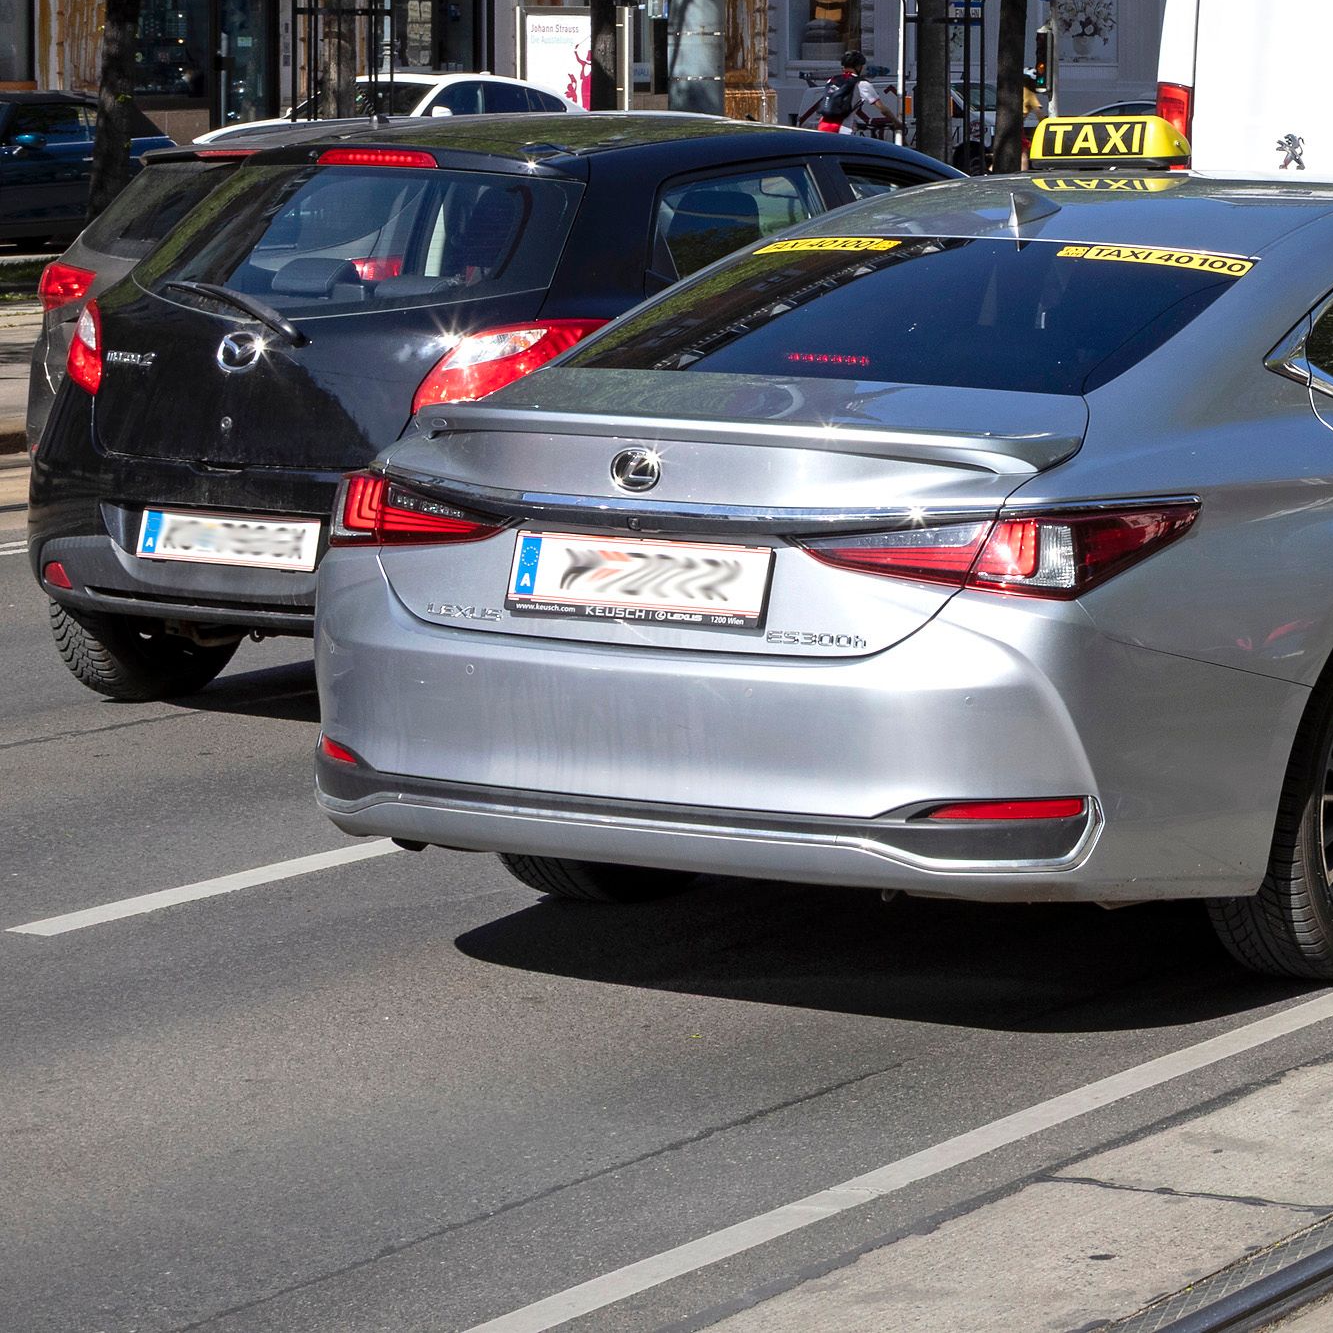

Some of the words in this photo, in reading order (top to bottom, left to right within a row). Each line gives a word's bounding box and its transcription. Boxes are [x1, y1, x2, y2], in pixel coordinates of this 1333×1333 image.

[530, 23, 554, 33] Johann
[555, 23, 580, 33] Strauss
[1049, 123, 1143, 155] TAXI
[1094, 247, 1154, 261] TAXI
[1156, 251, 1195, 265] 40
[1198, 256, 1247, 274] 100
[519, 571, 532, 588] A
[427, 602, 503, 622] LEXUS
[515, 602, 577, 614] www.keusch.com
[585, 606, 646, 620] KEUSCH
[667, 613, 703, 622] LEXUS
[710, 616, 727, 626] 1200
[727, 617, 745, 626] Wien
[766, 629, 867, 649] ES300h
